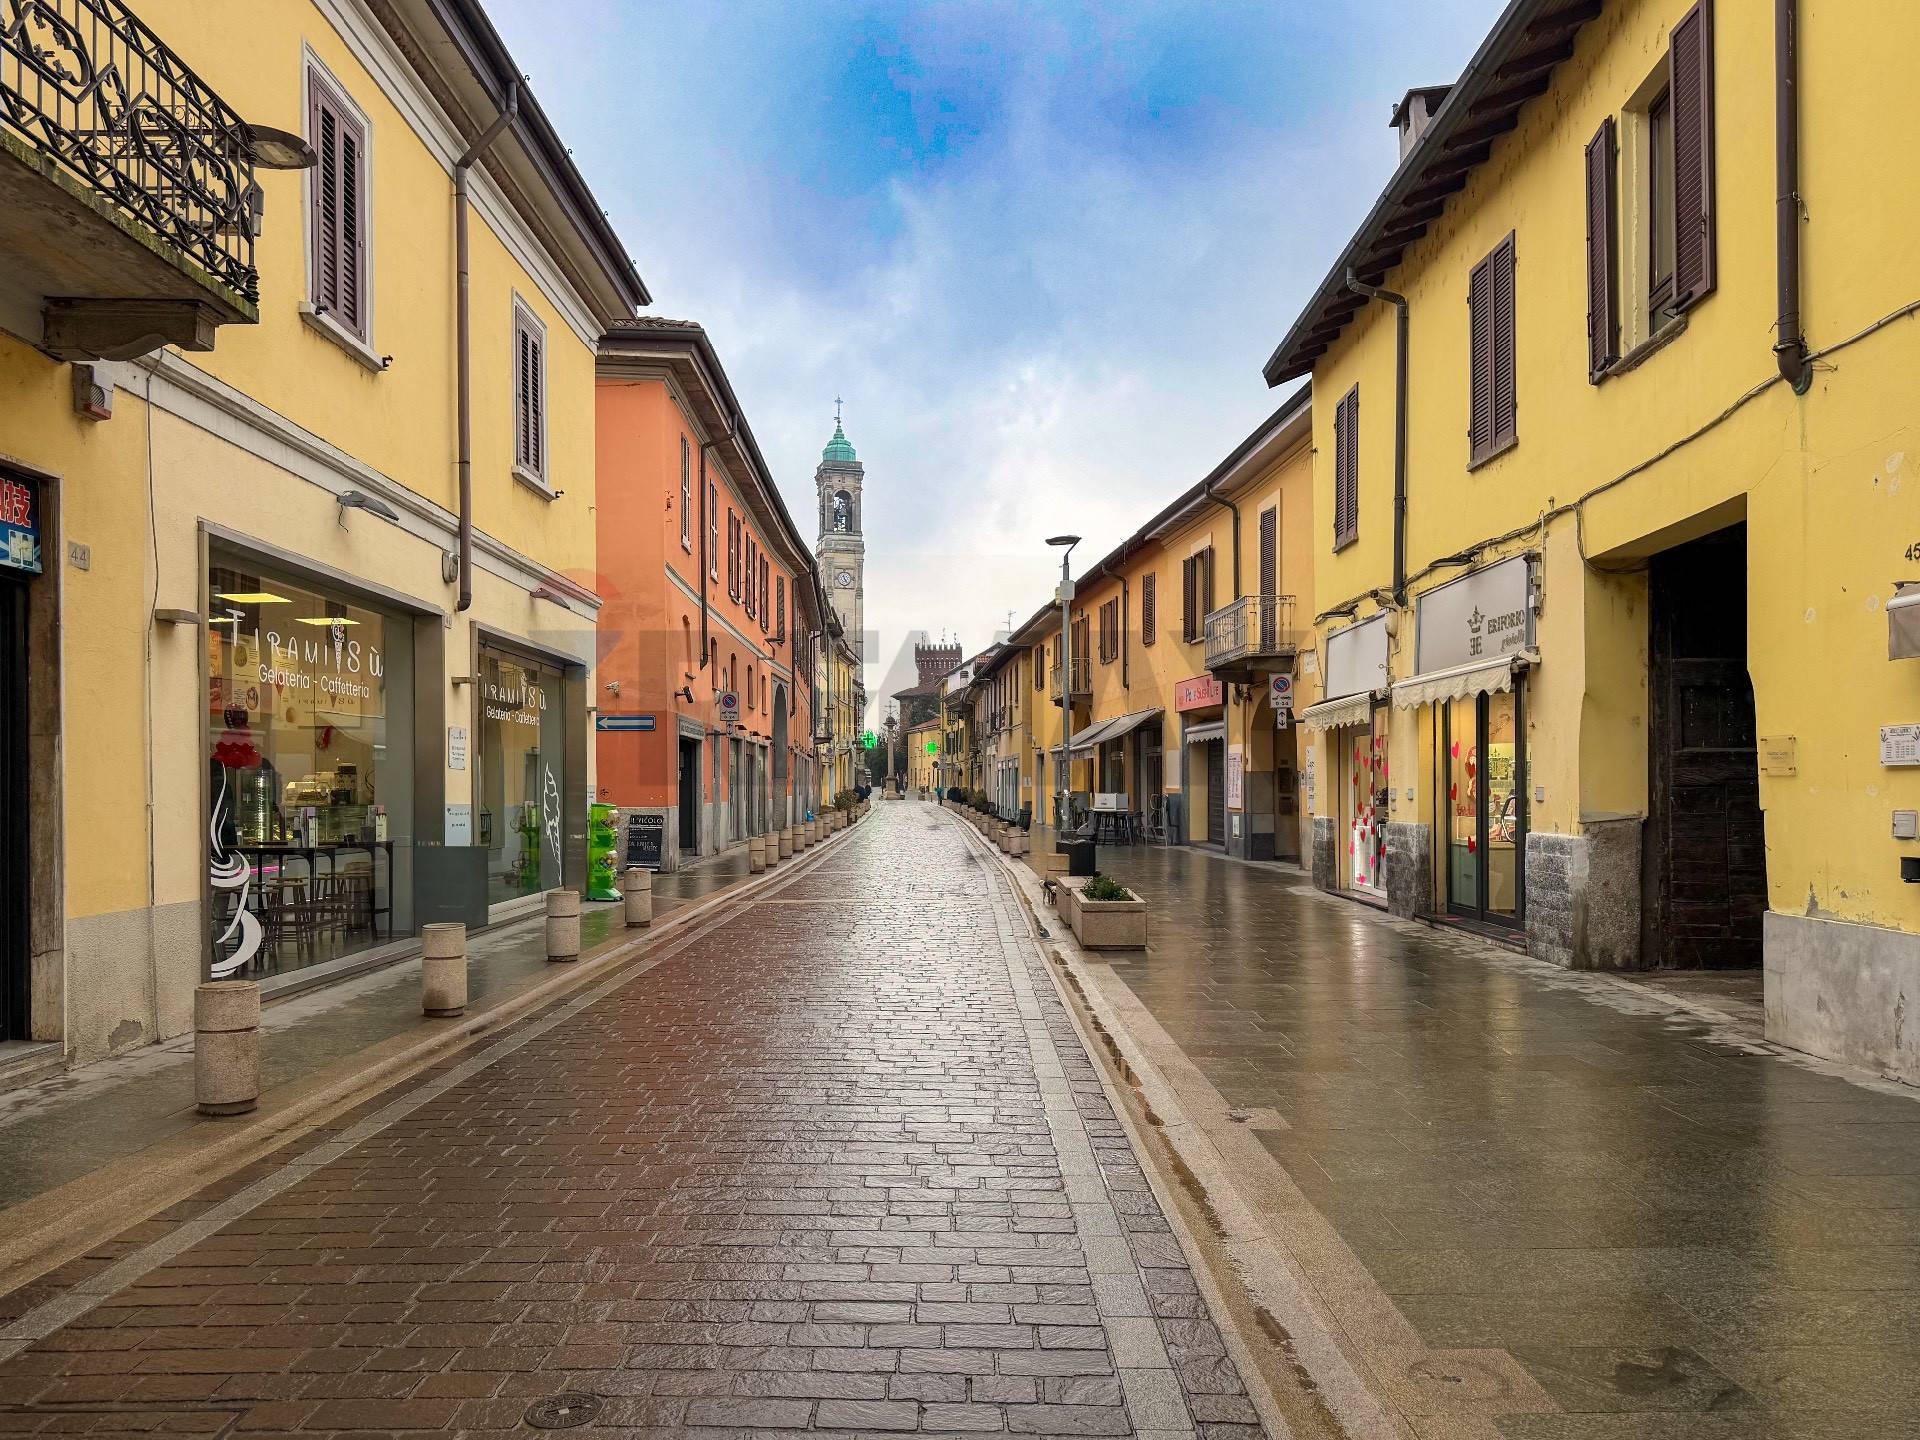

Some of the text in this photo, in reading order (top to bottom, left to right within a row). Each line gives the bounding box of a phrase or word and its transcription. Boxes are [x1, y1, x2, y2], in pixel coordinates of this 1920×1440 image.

[71, 547, 87, 561] 44
[1904, 542, 1920, 561] 45
[258, 664, 310, 688] Gelateria
[320, 675, 370, 698] Caffetteria
